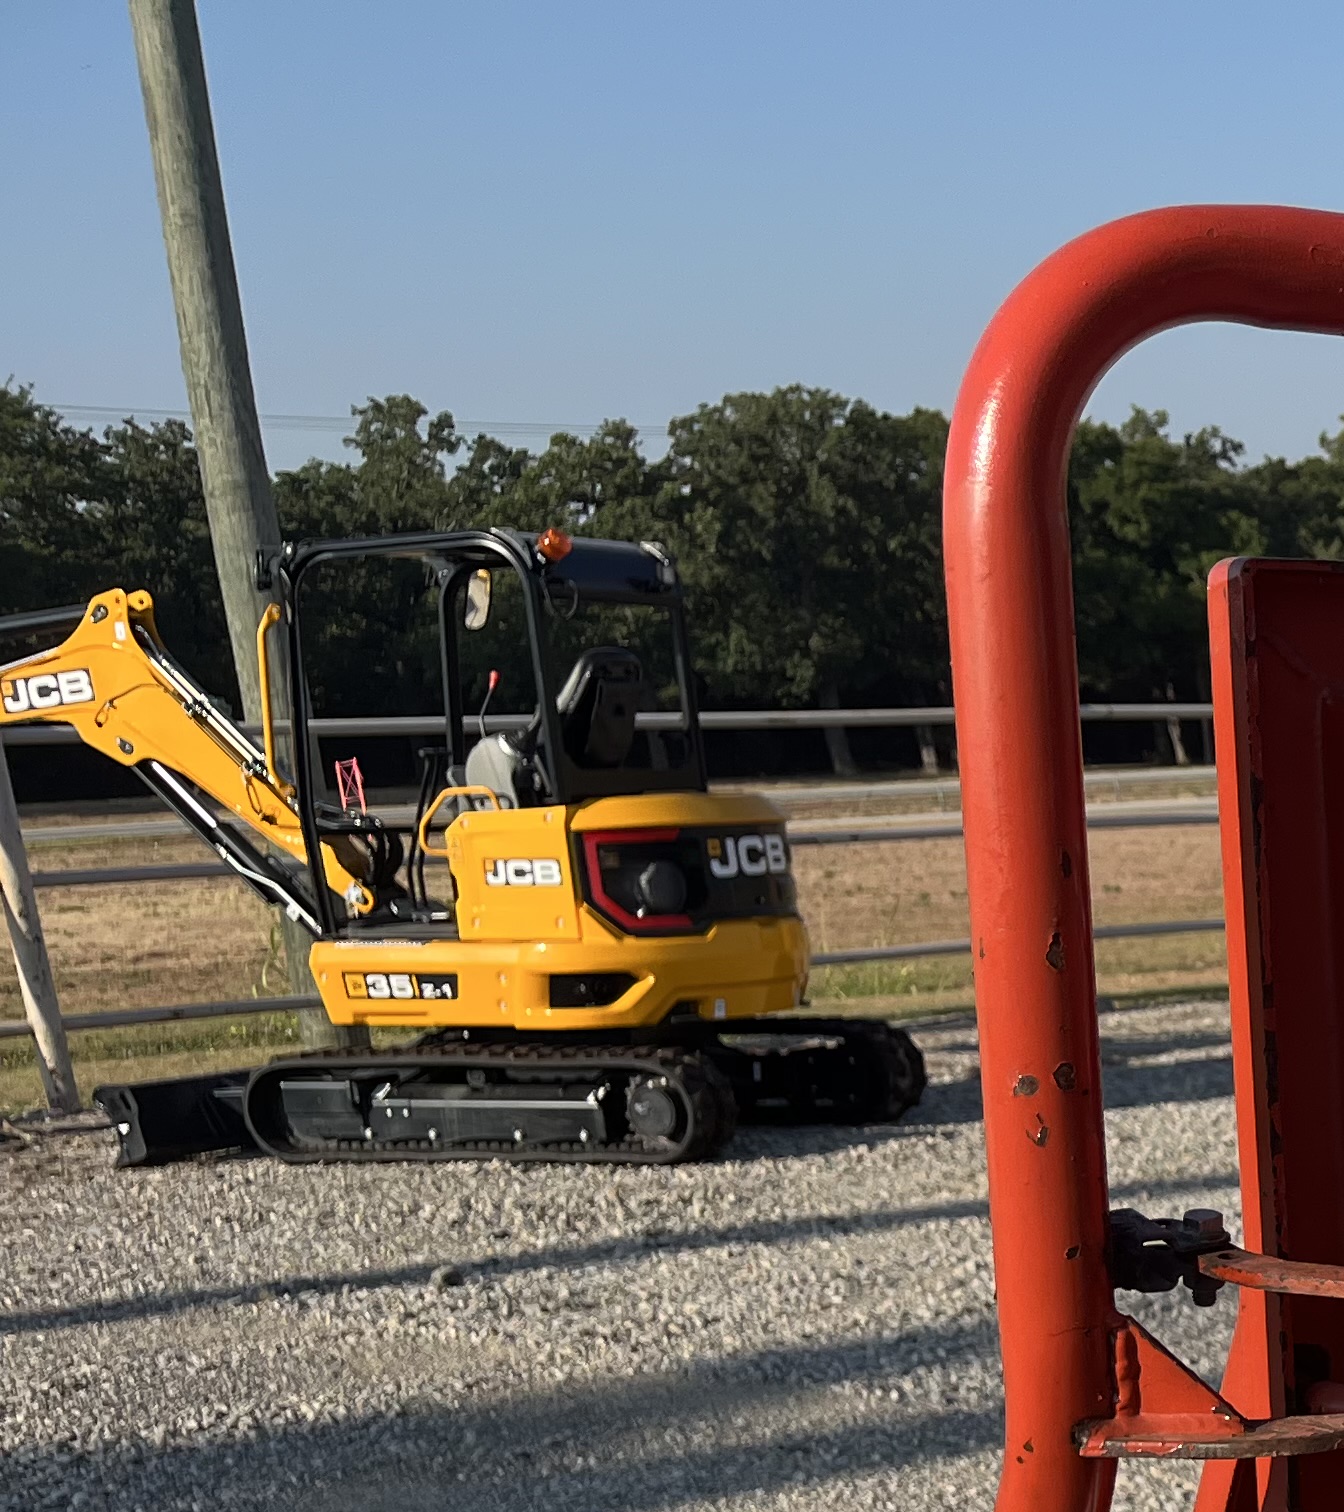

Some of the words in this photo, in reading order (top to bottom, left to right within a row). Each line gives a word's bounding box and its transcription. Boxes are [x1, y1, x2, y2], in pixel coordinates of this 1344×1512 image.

[2, 670, 94, 713] JCB
[485, 859, 562, 886] JCB
[709, 834, 787, 879] JCB
[366, 974, 414, 998] 35
